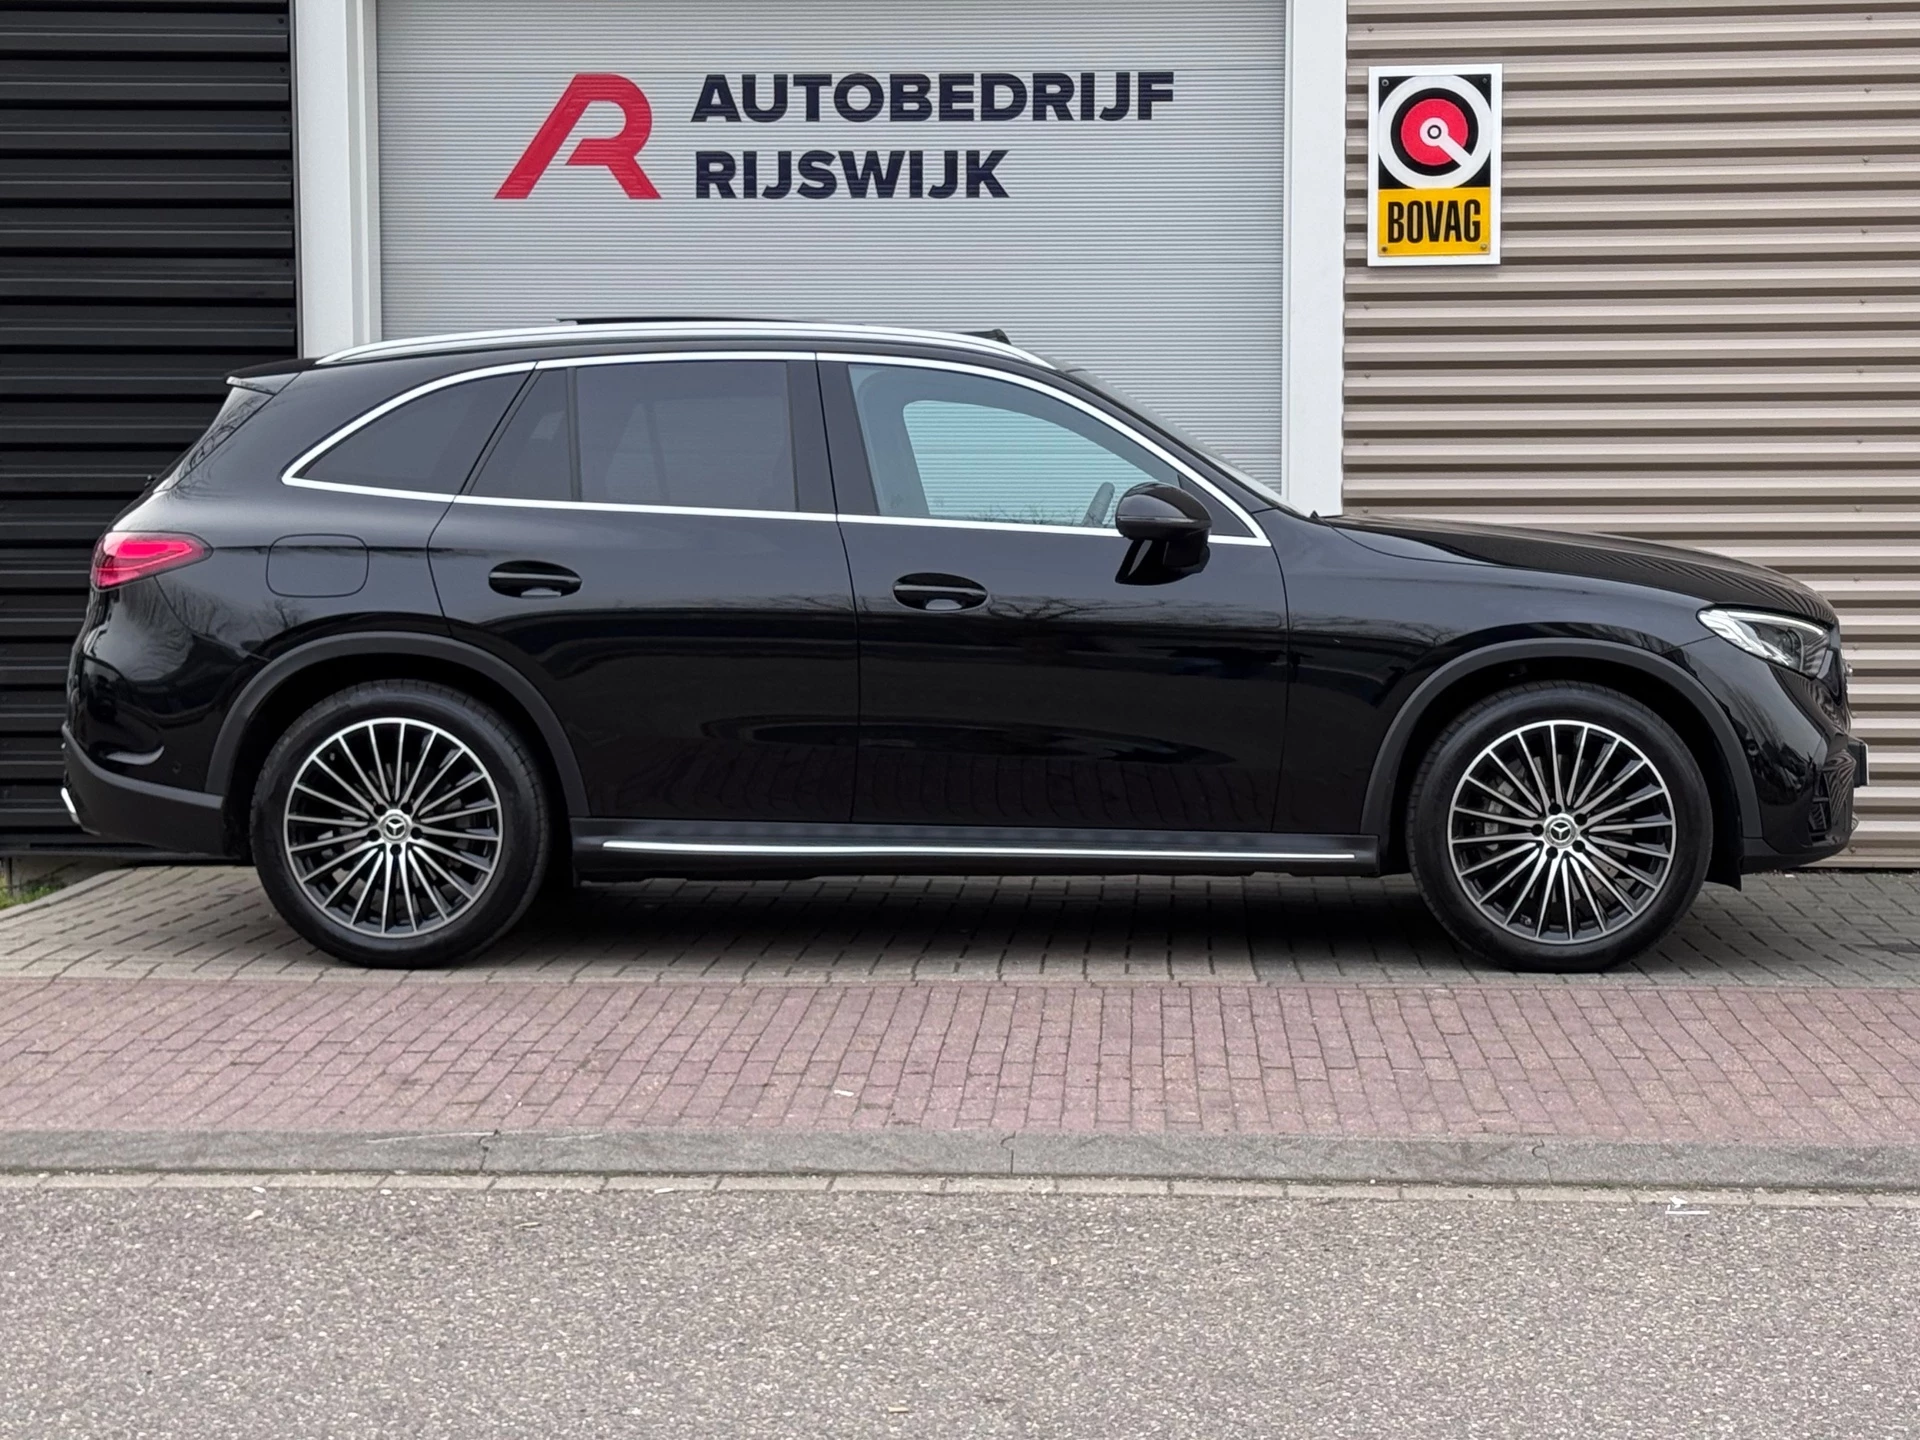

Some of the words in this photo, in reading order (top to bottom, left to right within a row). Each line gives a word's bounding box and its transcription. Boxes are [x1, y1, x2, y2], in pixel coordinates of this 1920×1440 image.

[691, 72, 1174, 122] AUTOBEDRIJF
[695, 150, 1010, 199] RIJSWIJK
[1387, 199, 1481, 243] BOVAG
